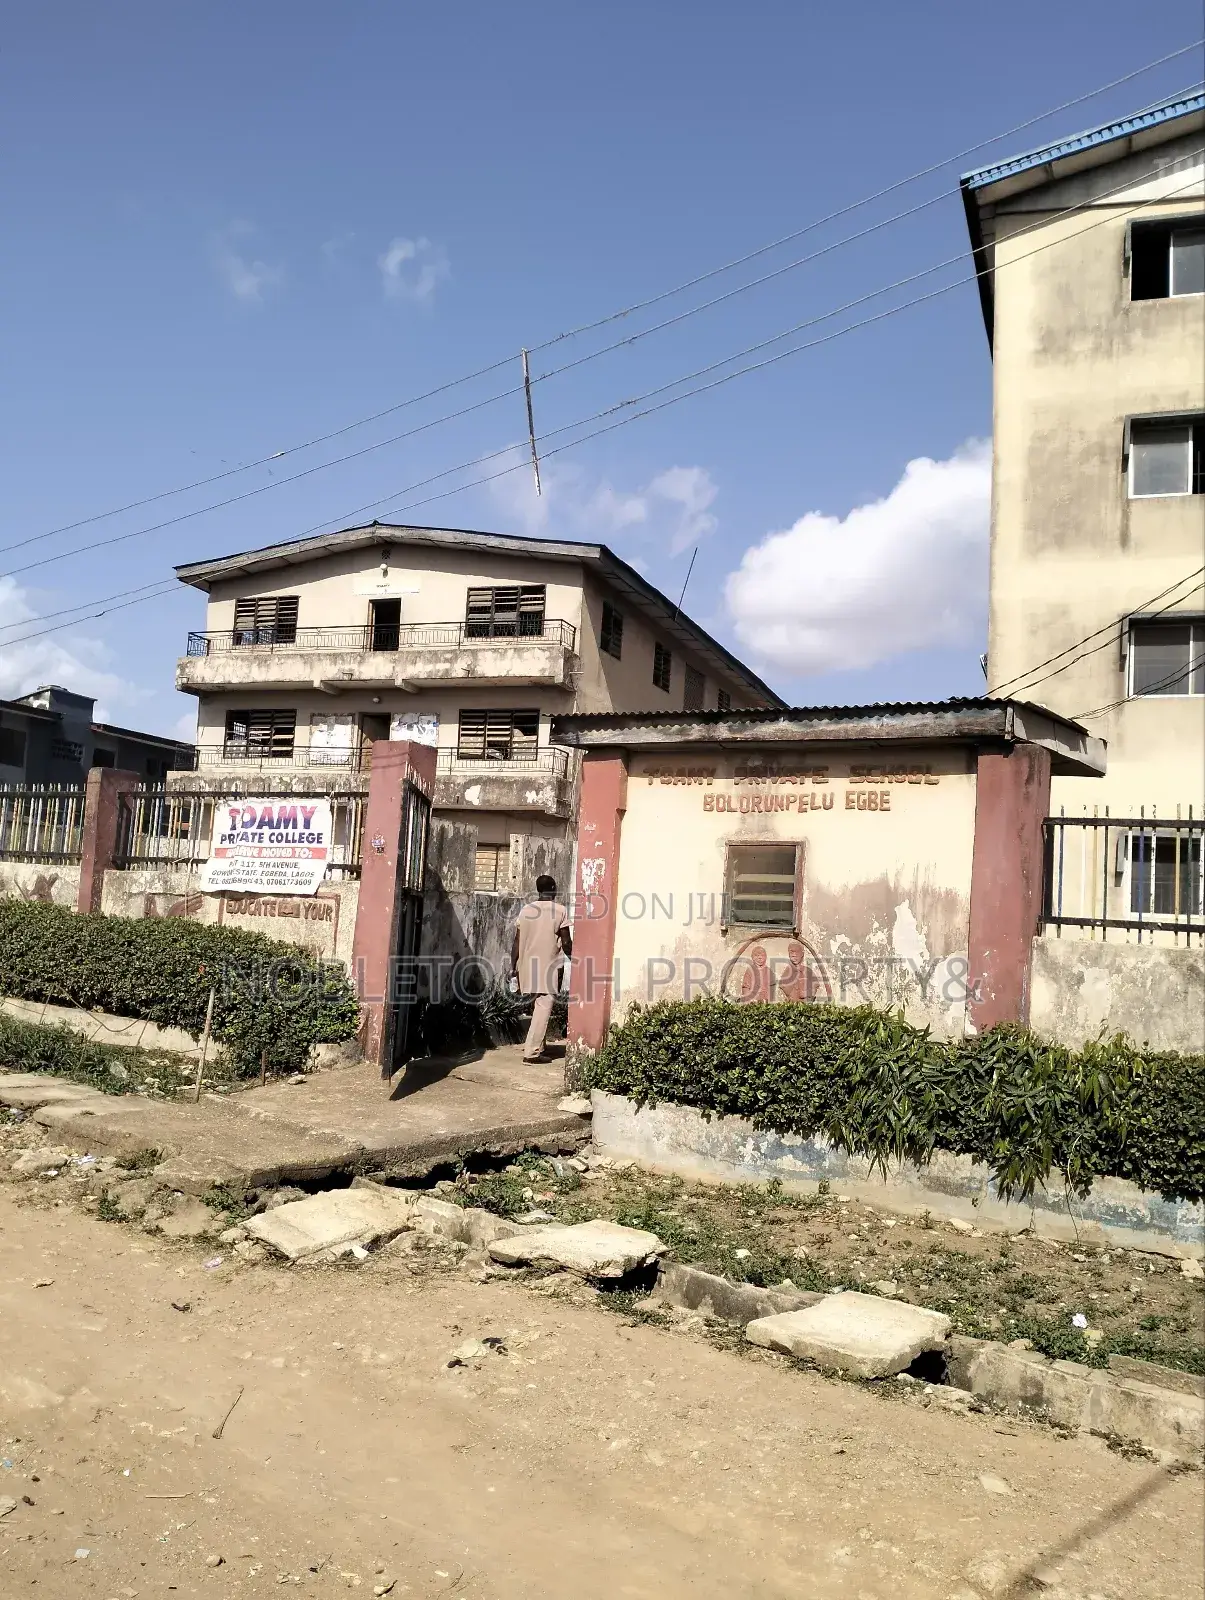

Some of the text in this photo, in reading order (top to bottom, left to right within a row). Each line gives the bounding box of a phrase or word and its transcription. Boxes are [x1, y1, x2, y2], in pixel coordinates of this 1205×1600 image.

[733, 764, 829, 786] PRIVATE
[849, 764, 940, 786] SCHOOL
[703, 791, 891, 813] BOLORUNPELU EGBE
[228, 805, 318, 831] TOAMY
[268, 832, 324, 845] COLLEGE
[294, 847, 313, 859] TO:
[225, 898, 333, 922] EDUCATE YOUR
